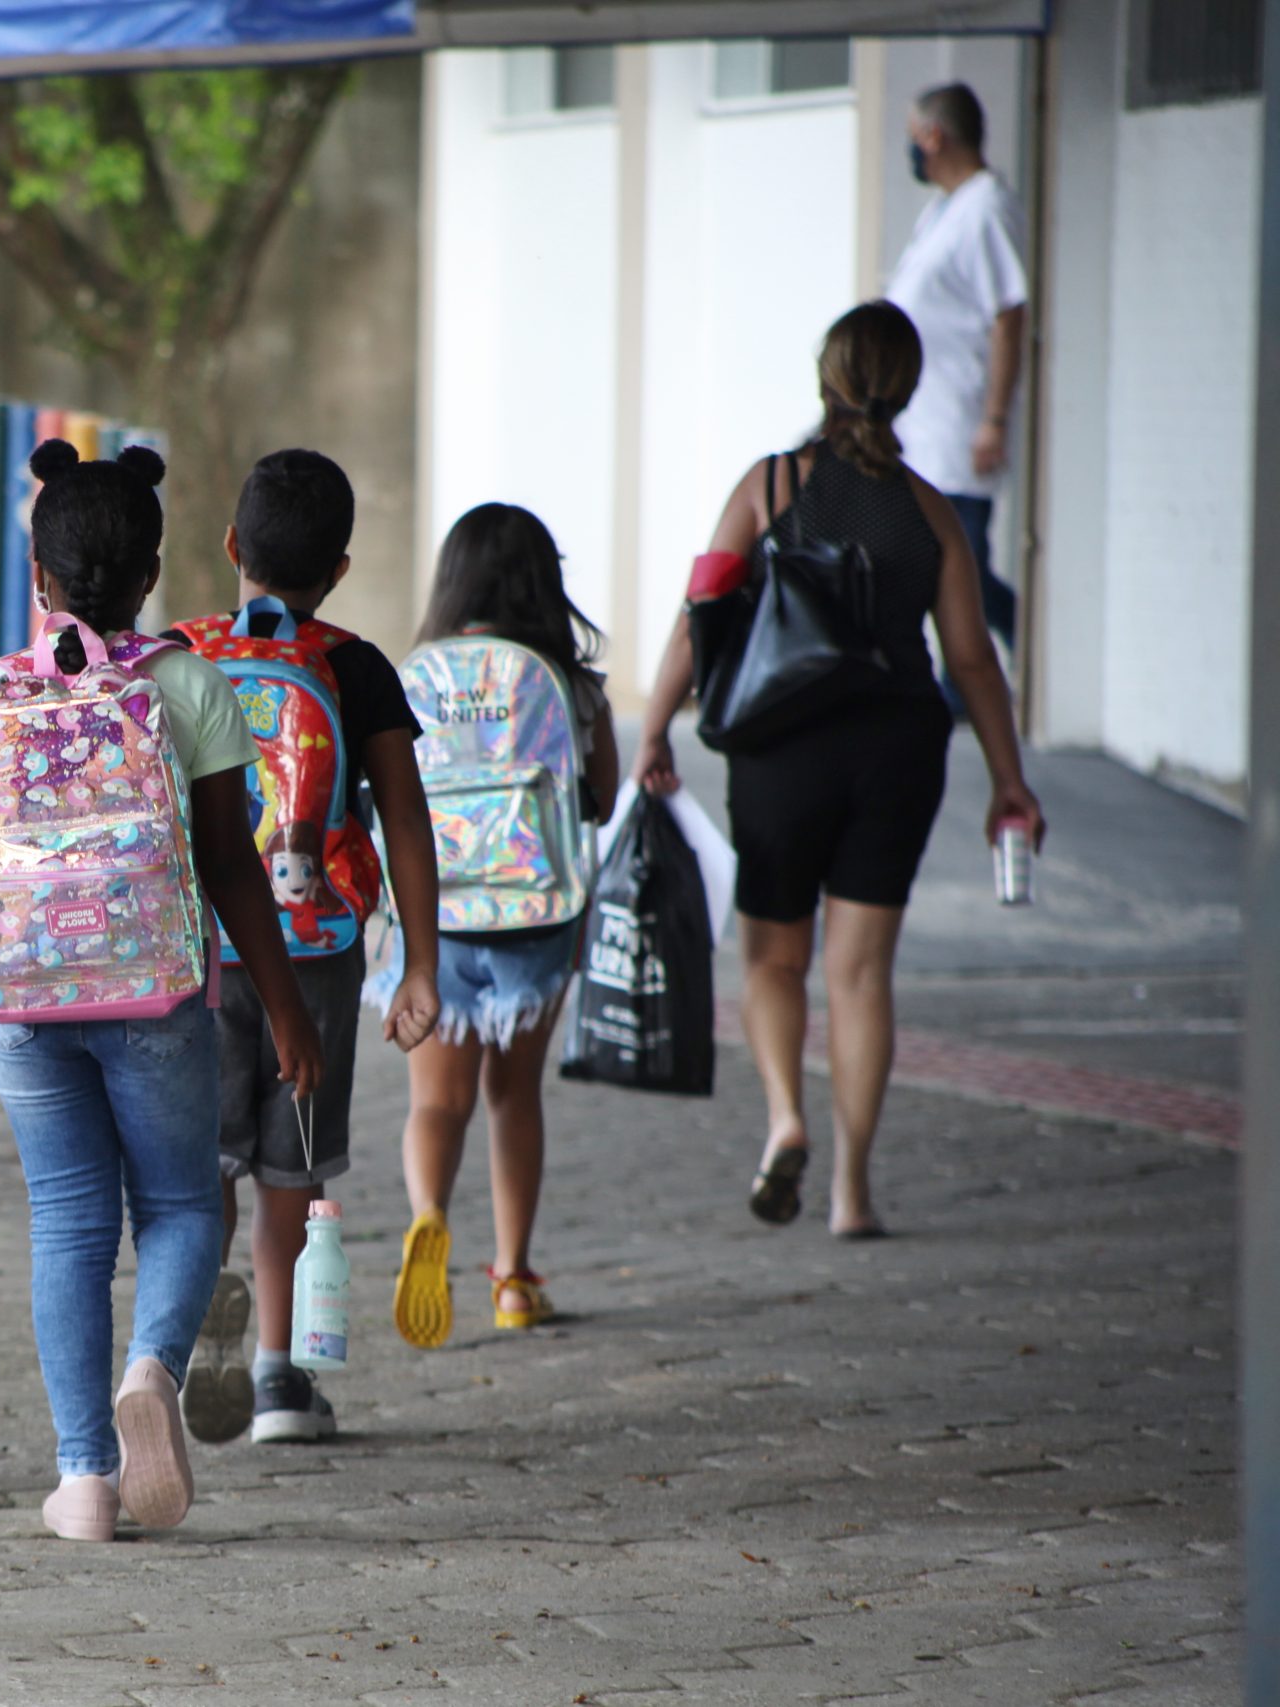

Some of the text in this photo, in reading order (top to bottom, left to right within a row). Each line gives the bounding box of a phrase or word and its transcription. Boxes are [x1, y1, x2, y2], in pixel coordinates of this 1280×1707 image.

[436, 706, 509, 724] UNITED
[59, 909, 94, 920] UNICORN
[67, 918, 88, 928] LOVE
